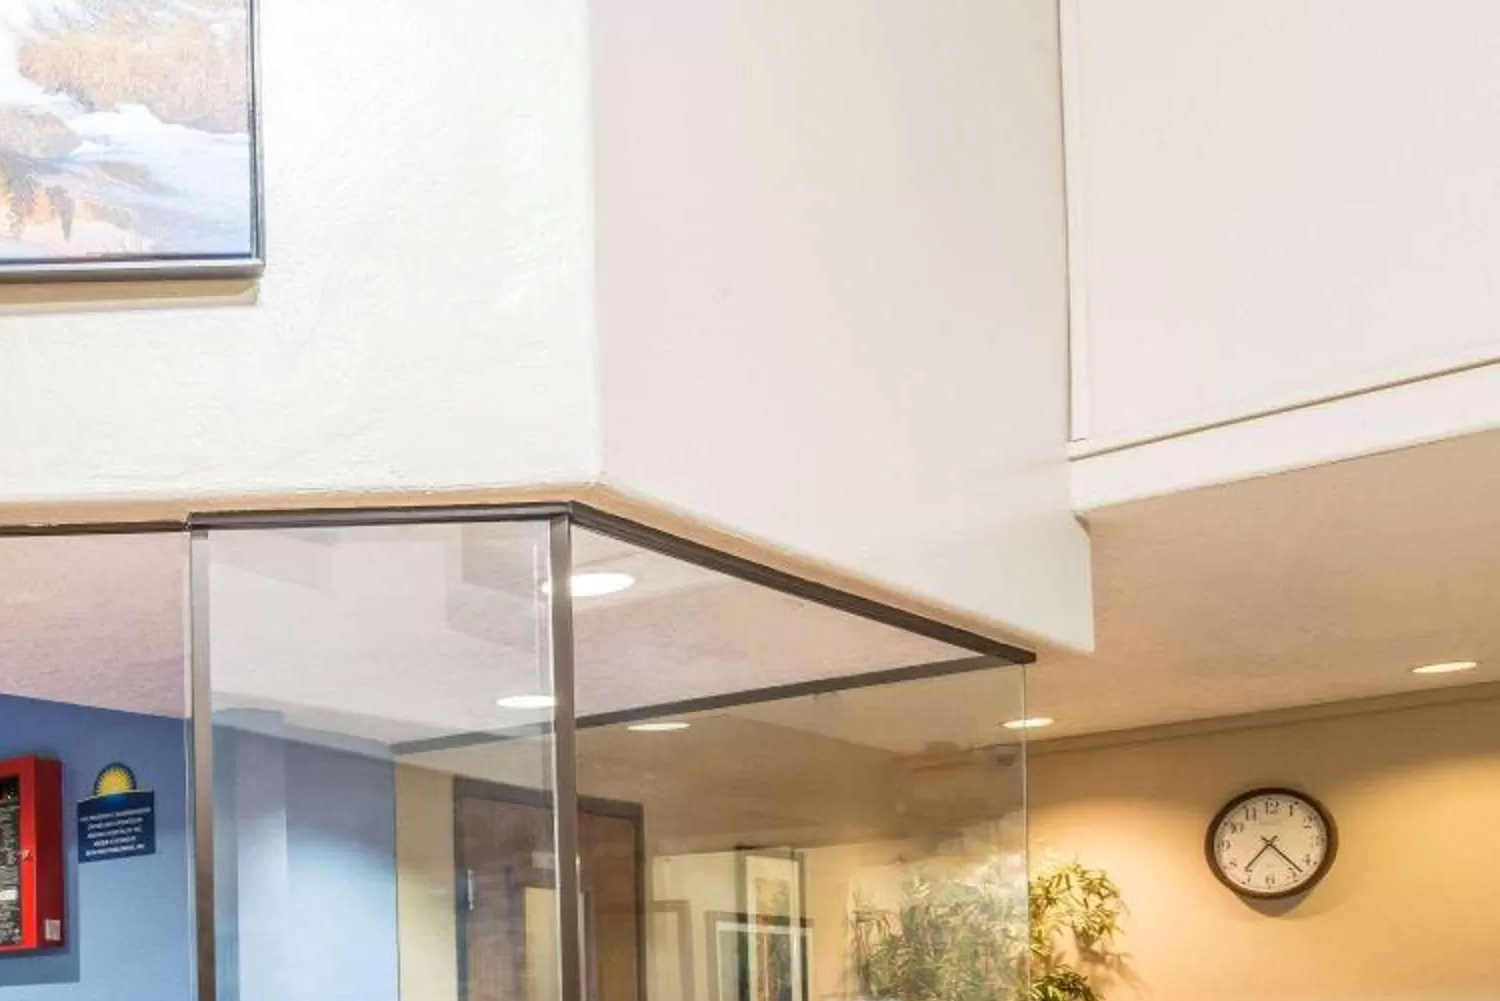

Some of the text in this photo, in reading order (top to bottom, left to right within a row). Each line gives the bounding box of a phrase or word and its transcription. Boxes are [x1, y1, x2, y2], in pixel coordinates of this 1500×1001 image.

[1244, 805, 1257, 821] 11
[1265, 800, 1280, 816] 12
[1288, 803, 1294, 817] 1
[1303, 815, 1312, 829] 2
